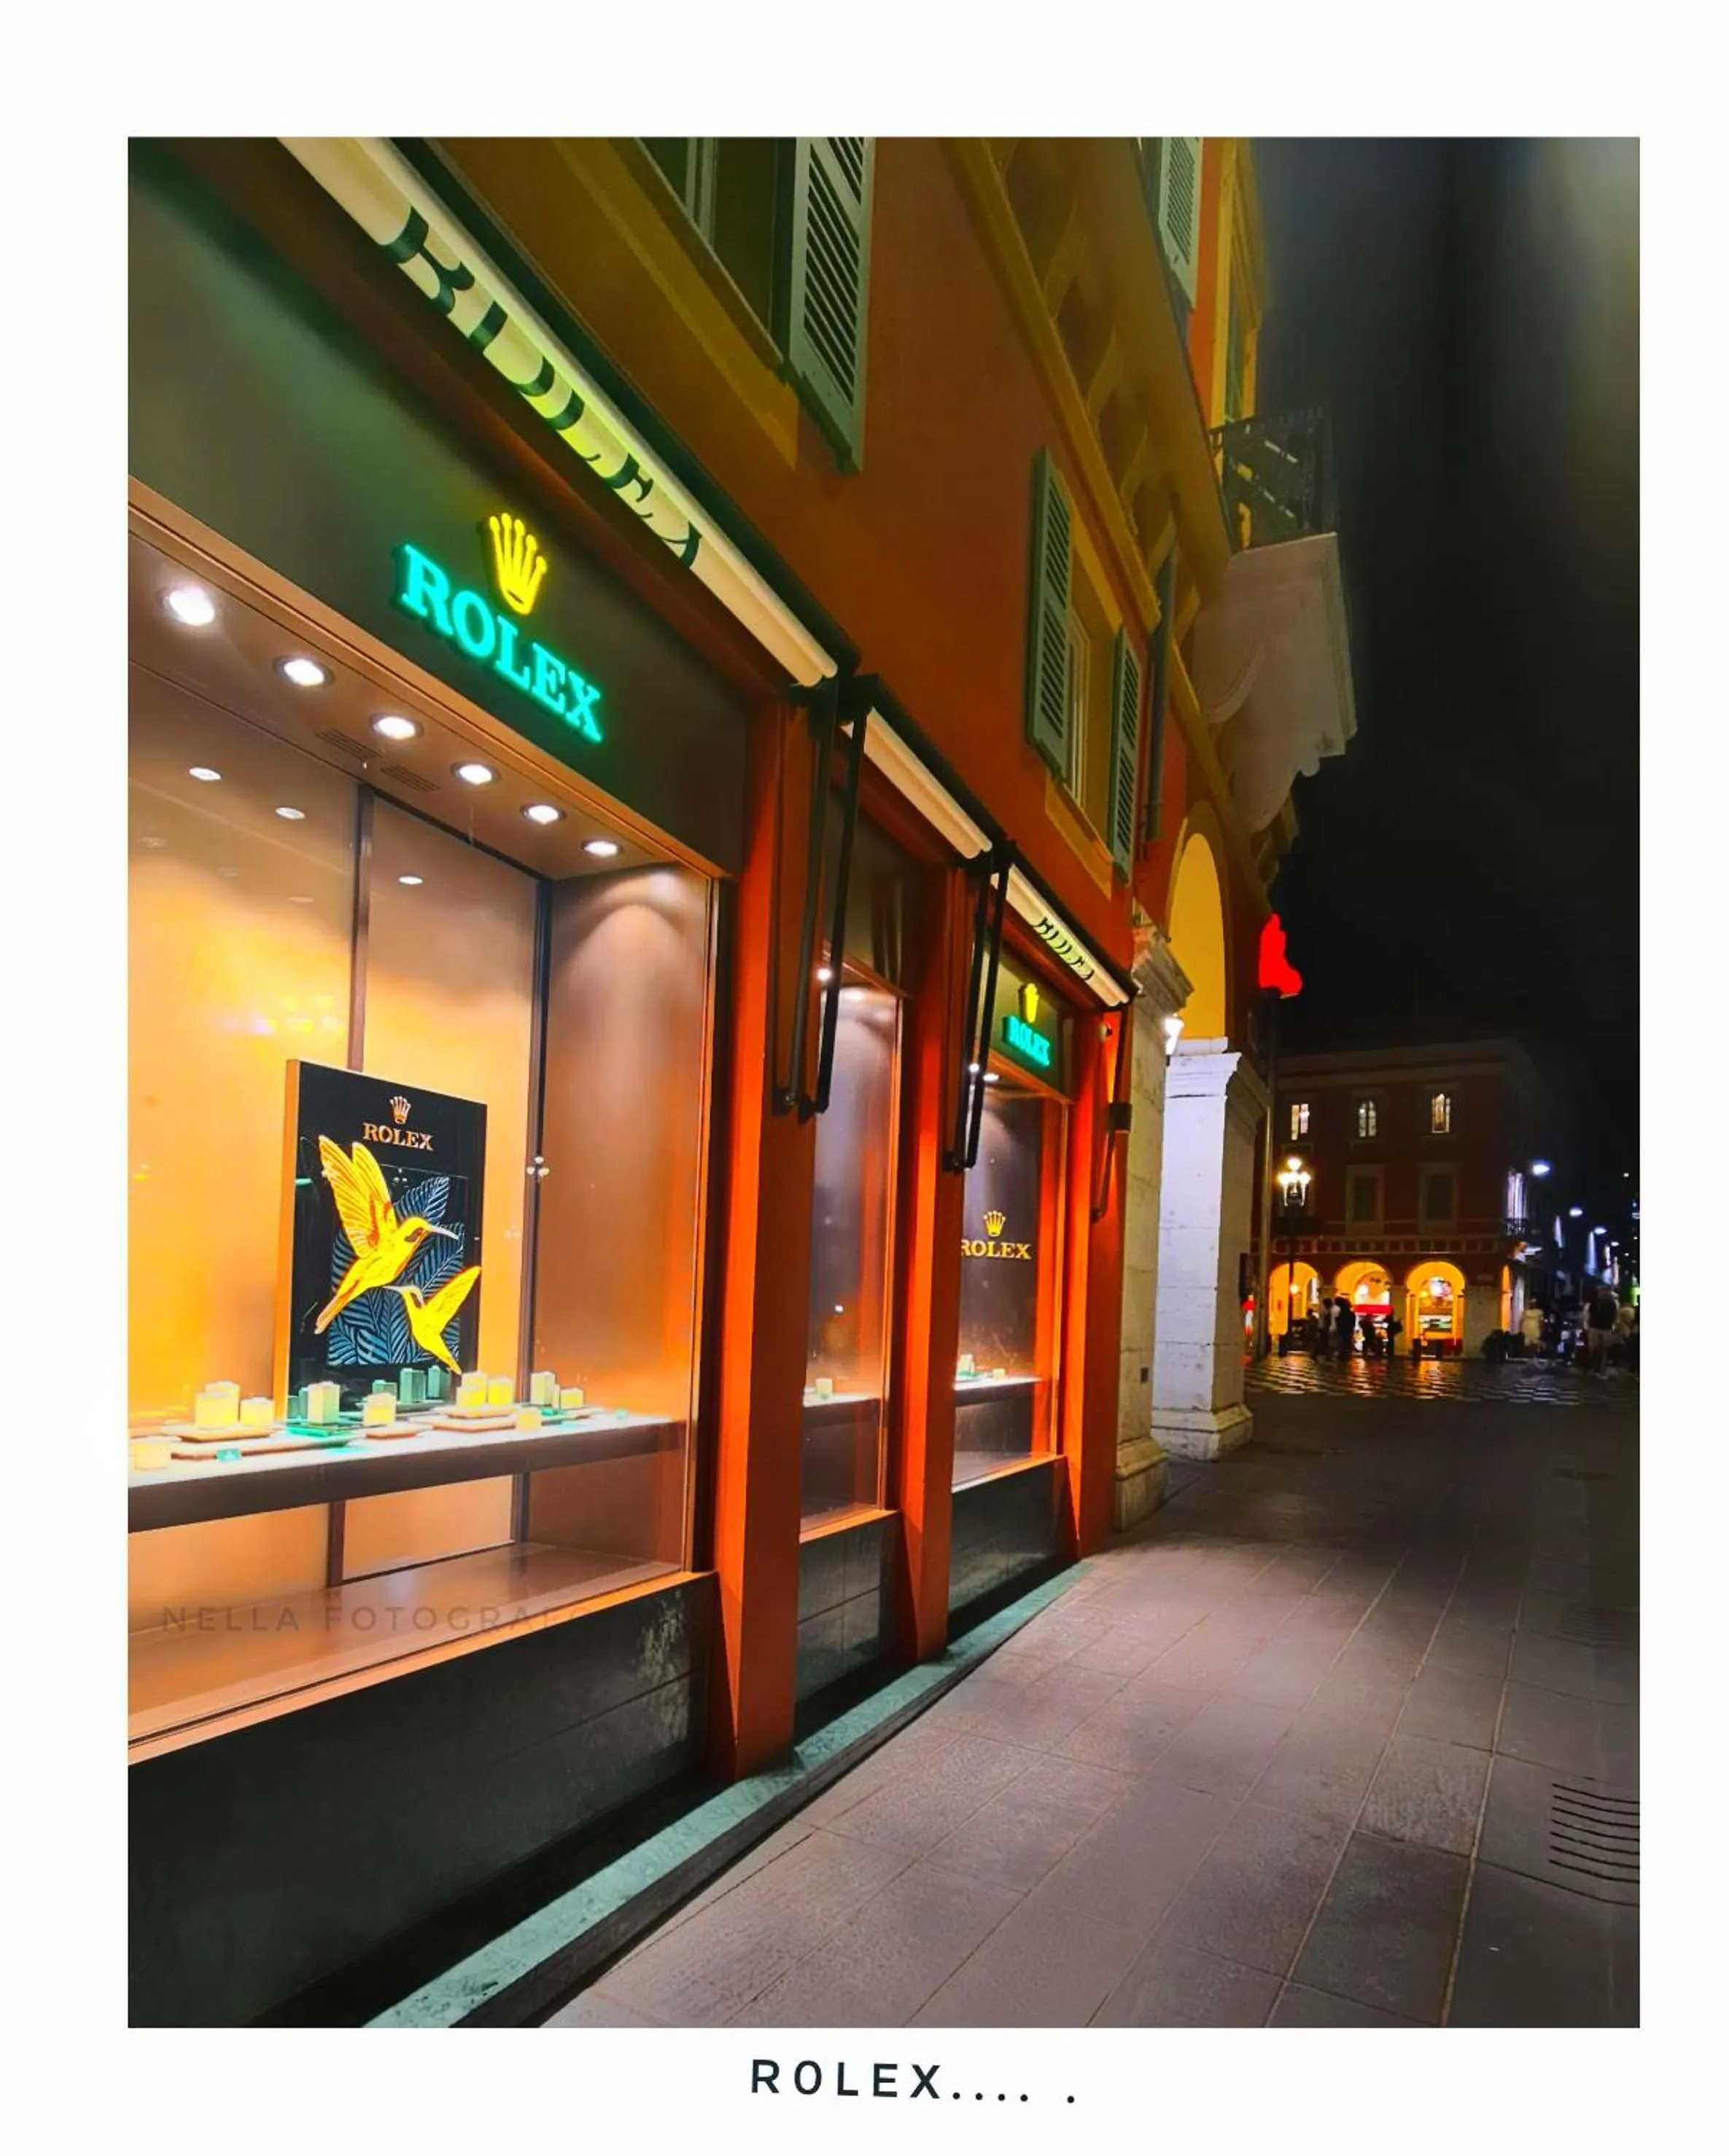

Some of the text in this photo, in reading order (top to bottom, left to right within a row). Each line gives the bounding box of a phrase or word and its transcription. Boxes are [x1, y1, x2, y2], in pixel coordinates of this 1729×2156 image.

[402, 544, 602, 742] ROLEX
[1008, 1015, 1050, 1066] ROLEX
[362, 1122, 434, 1151] ROLEX
